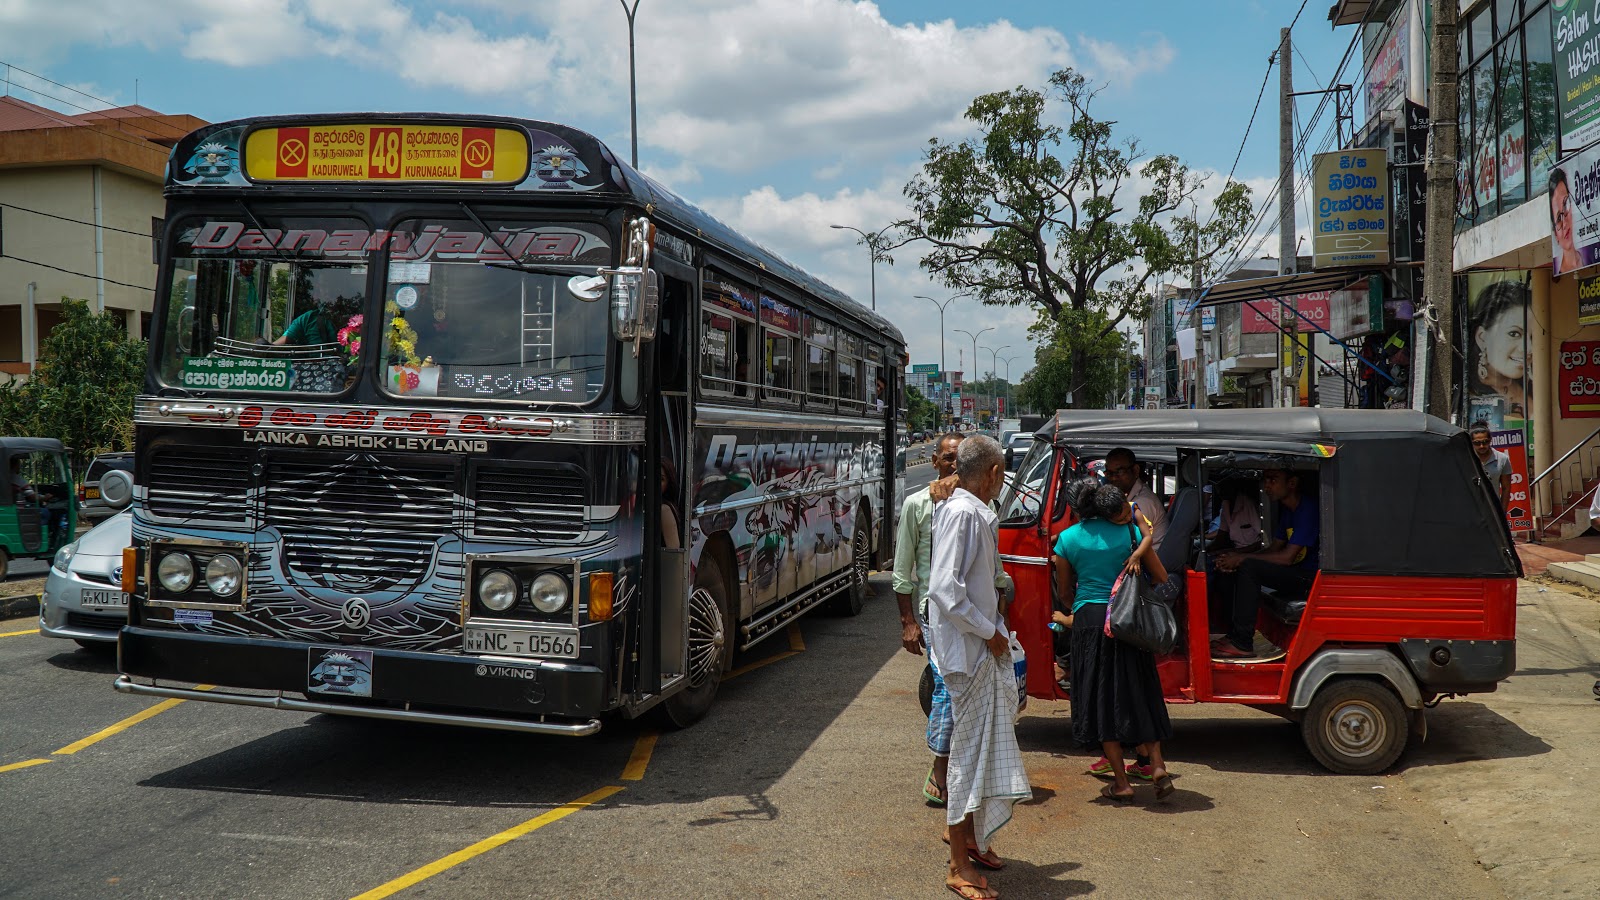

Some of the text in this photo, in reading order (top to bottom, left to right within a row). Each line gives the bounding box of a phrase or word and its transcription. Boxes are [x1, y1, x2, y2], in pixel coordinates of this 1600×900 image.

[1557, 10, 1589, 52] Salon
[1568, 34, 1600, 79] HASH
[313, 130, 365, 146] කදුරුවෙල
[406, 130, 459, 147] කුරුණෑගල
[371, 132, 399, 174] 48
[312, 164, 363, 176] KADURUWELA
[405, 166, 457, 178] KURUNAGALA
[1347, 219, 1385, 231] සමාගම
[192, 221, 581, 262] Dananjaya
[1561, 346, 1587, 370] දත්
[243, 430, 306, 445] LANKA
[1508, 433, 1522, 445] Lab
[94, 591, 109, 604] KU
[484, 632, 574, 655] NC 0566
[489, 667, 535, 680] VIKING
